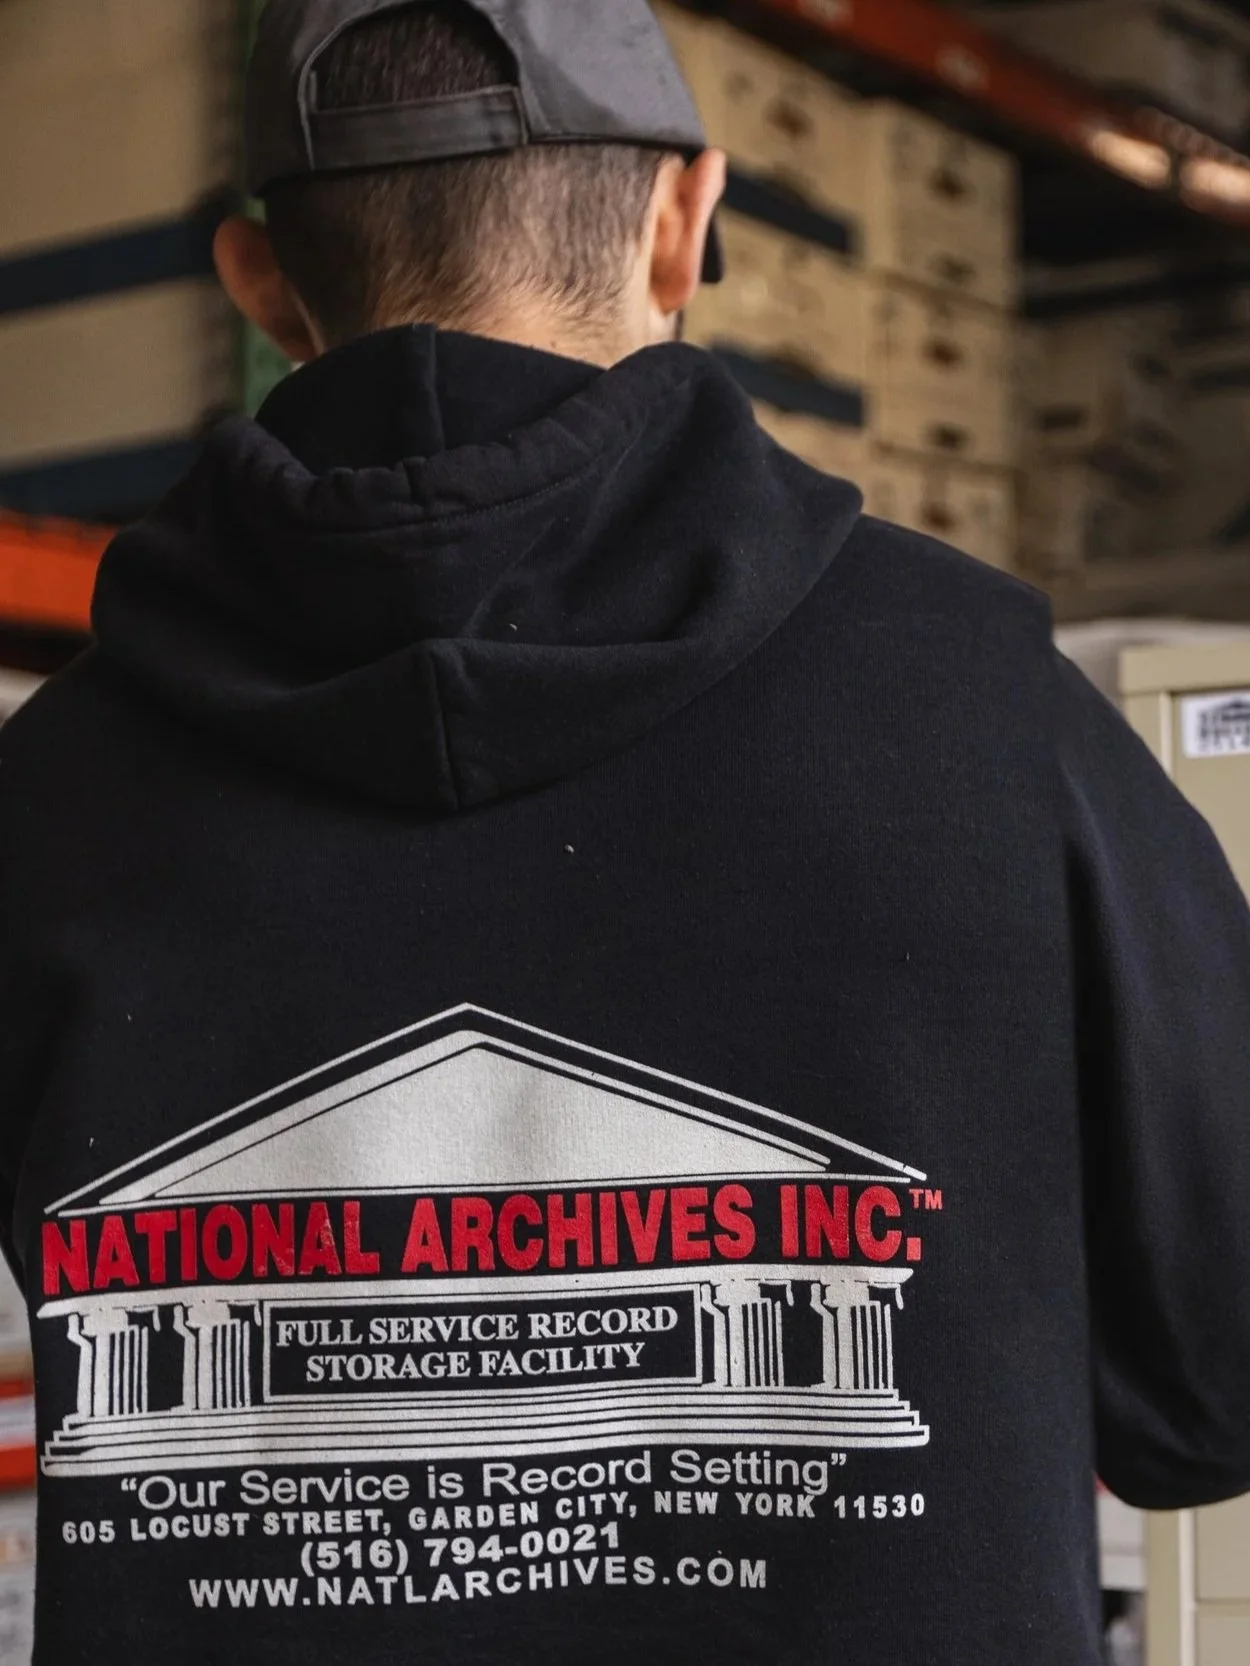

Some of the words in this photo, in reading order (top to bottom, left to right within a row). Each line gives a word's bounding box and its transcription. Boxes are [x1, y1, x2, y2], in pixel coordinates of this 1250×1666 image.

[41, 1198, 380, 1296] NATIONAL
[401, 1183, 756, 1273] ARCHIVES
[276, 1318, 363, 1348] FULL
[369, 1313, 519, 1345] SERVICE
[528, 1305, 679, 1340] RECORD
[306, 1351, 471, 1382] STORAGE
[479, 1341, 646, 1377] FACILITY
[239, 1469, 410, 1505] Service
[427, 1465, 465, 1499] is
[482, 1450, 652, 1497] Record
[62, 1519, 116, 1544] 605
[130, 1512, 250, 1541] LOCUST
[262, 1508, 392, 1537] STREET,
[408, 1501, 539, 1531] GARDEN
[556, 1491, 637, 1519] CITY,
[654, 1490, 719, 1514] NEW
[737, 1494, 816, 1519] YORK
[833, 1493, 925, 1519] 11530
[300, 1538, 409, 1577] (516)
[422, 1521, 620, 1568] 794-0021
[188, 1555, 768, 1609] WWW.NATLARCHIVES.COM
